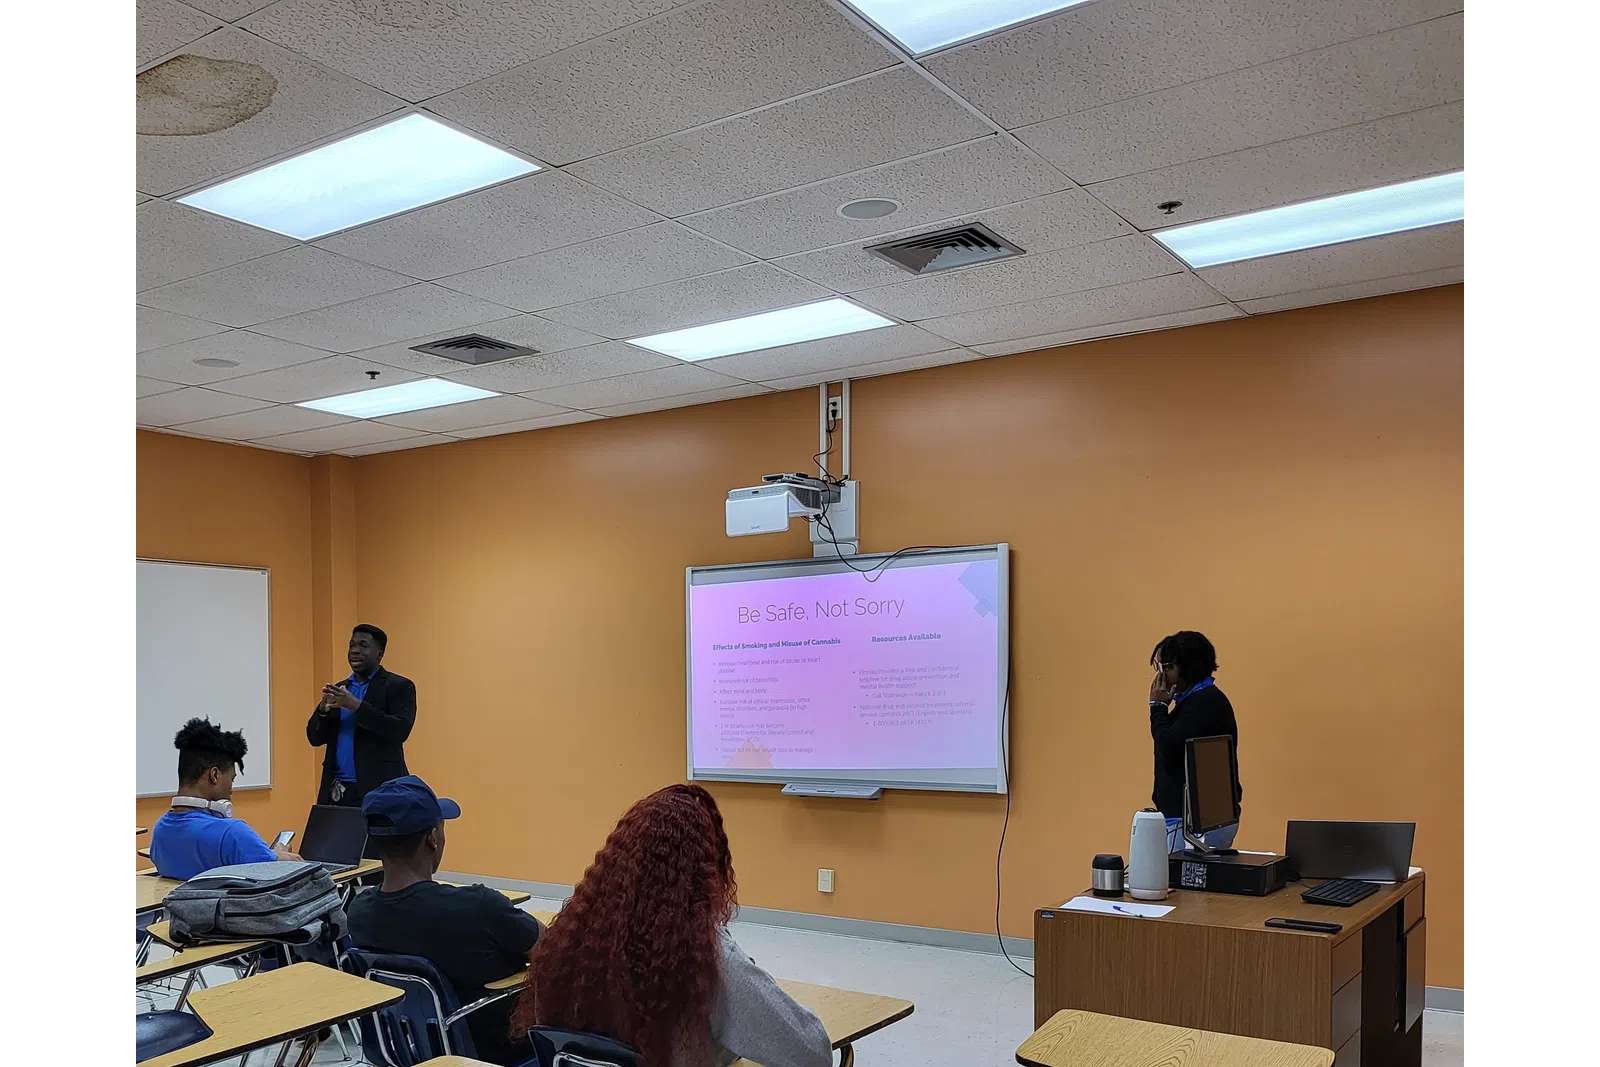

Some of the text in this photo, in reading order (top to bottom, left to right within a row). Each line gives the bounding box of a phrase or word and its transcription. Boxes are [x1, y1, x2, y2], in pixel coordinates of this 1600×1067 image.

[738, 597, 905, 624] Be Safe, Not Sorry
